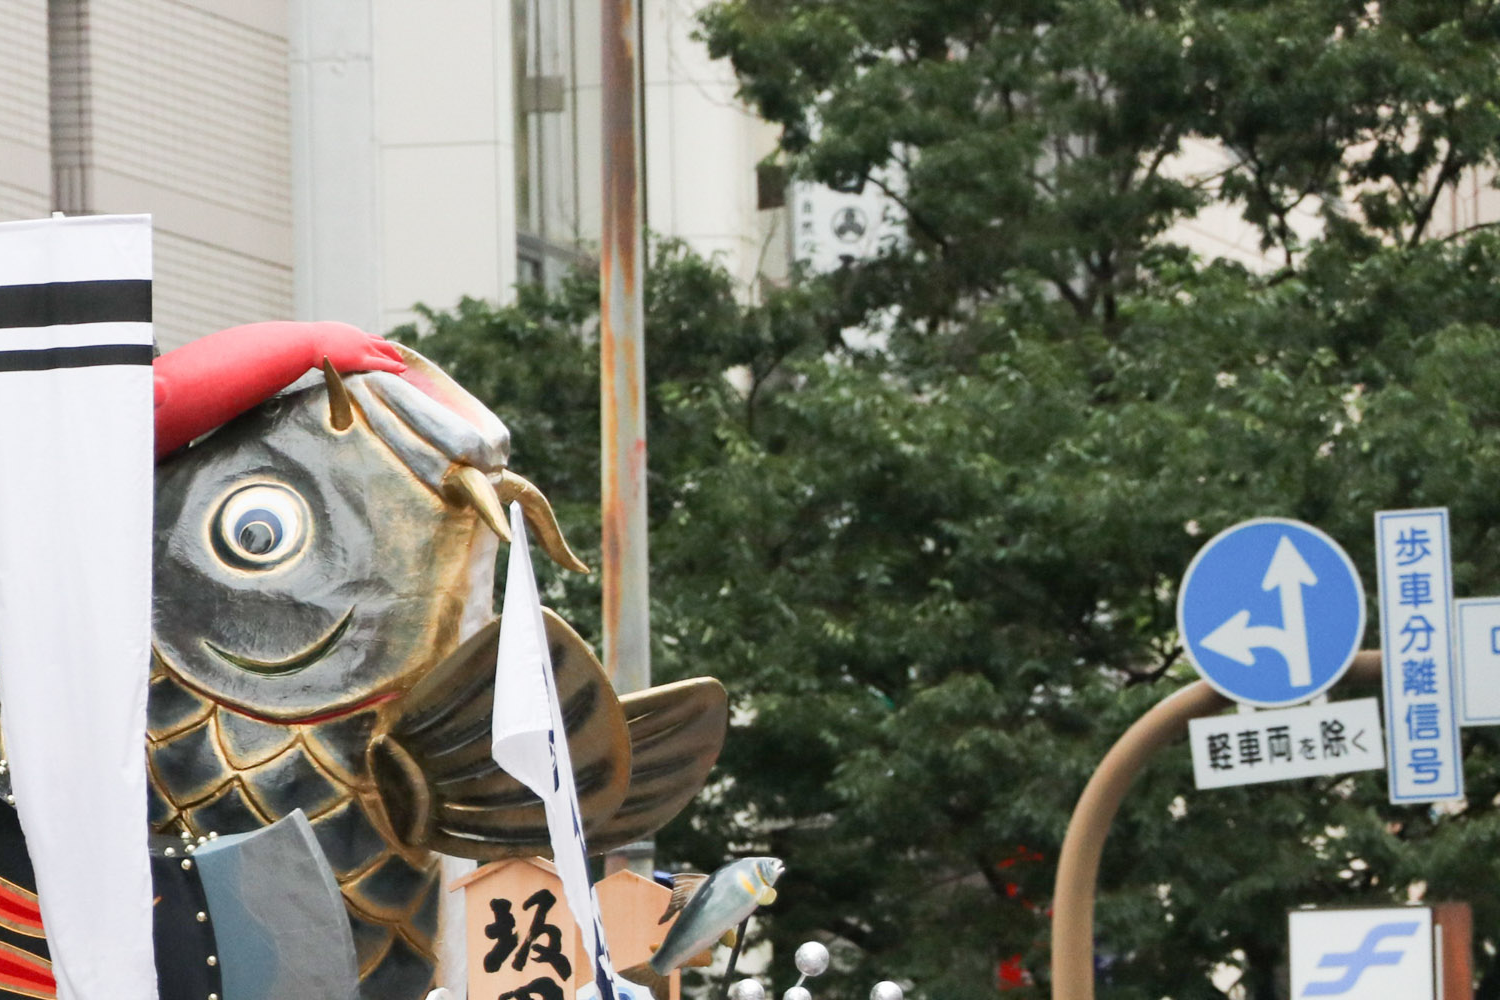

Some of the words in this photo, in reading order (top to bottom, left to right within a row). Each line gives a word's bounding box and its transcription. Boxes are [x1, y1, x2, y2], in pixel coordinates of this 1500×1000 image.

[1395, 527, 1443, 786] 歩車分離信号
[1206, 718, 1369, 772] 軽車両を除く
